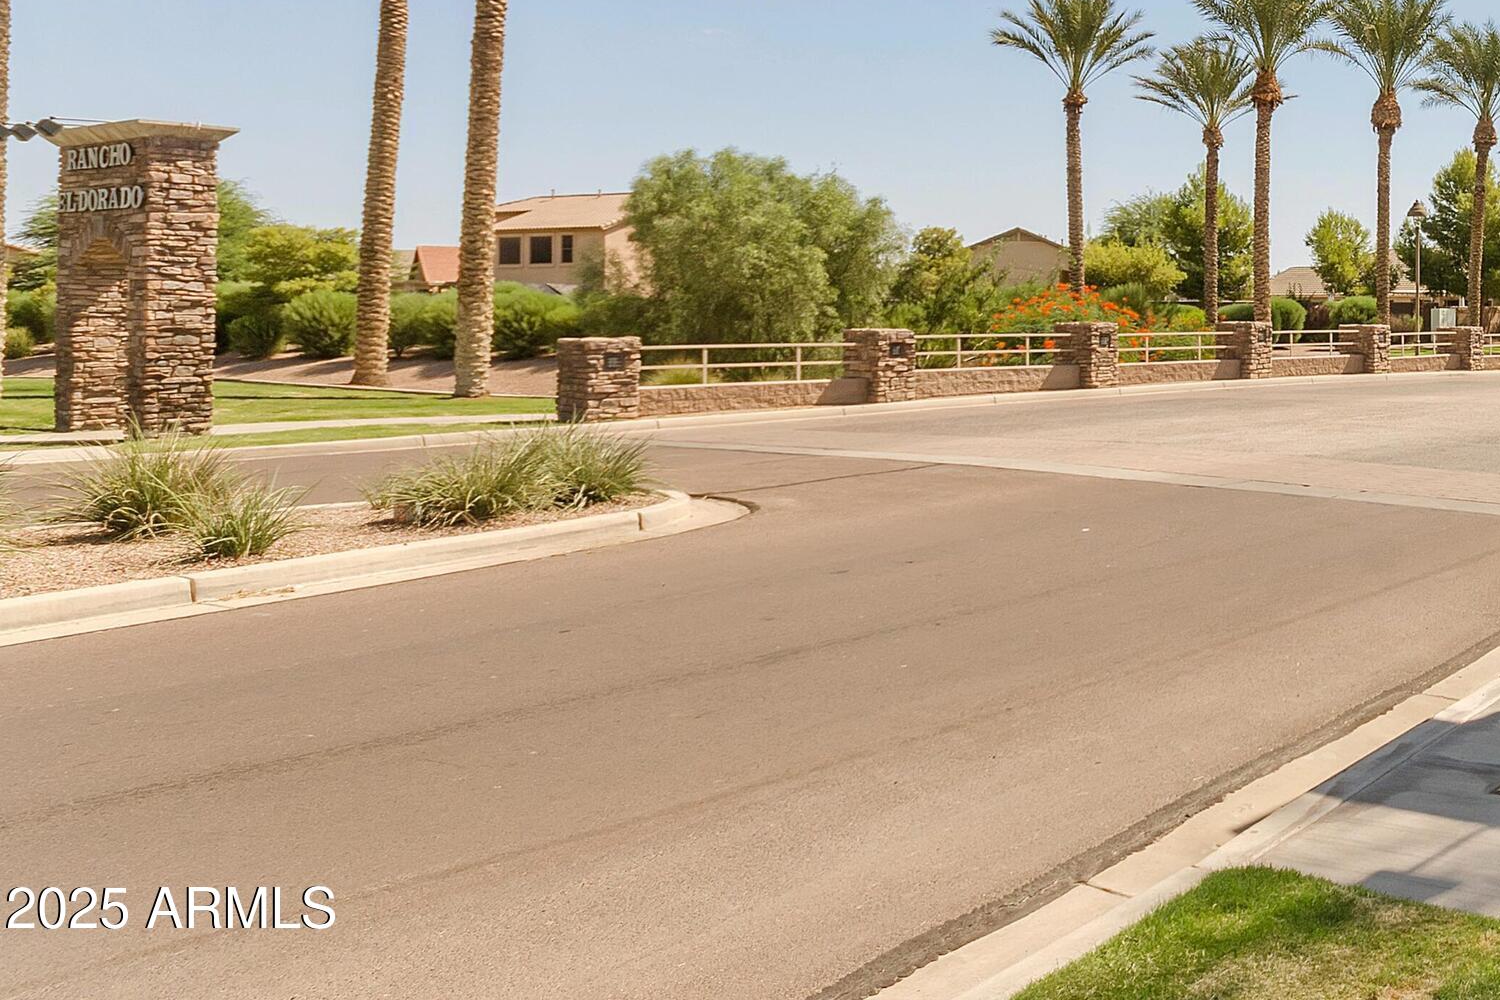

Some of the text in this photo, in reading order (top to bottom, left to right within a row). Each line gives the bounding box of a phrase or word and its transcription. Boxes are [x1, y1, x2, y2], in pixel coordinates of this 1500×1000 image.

[66, 142, 131, 171] RANCHO
[58, 185, 144, 213] EL DORADO
